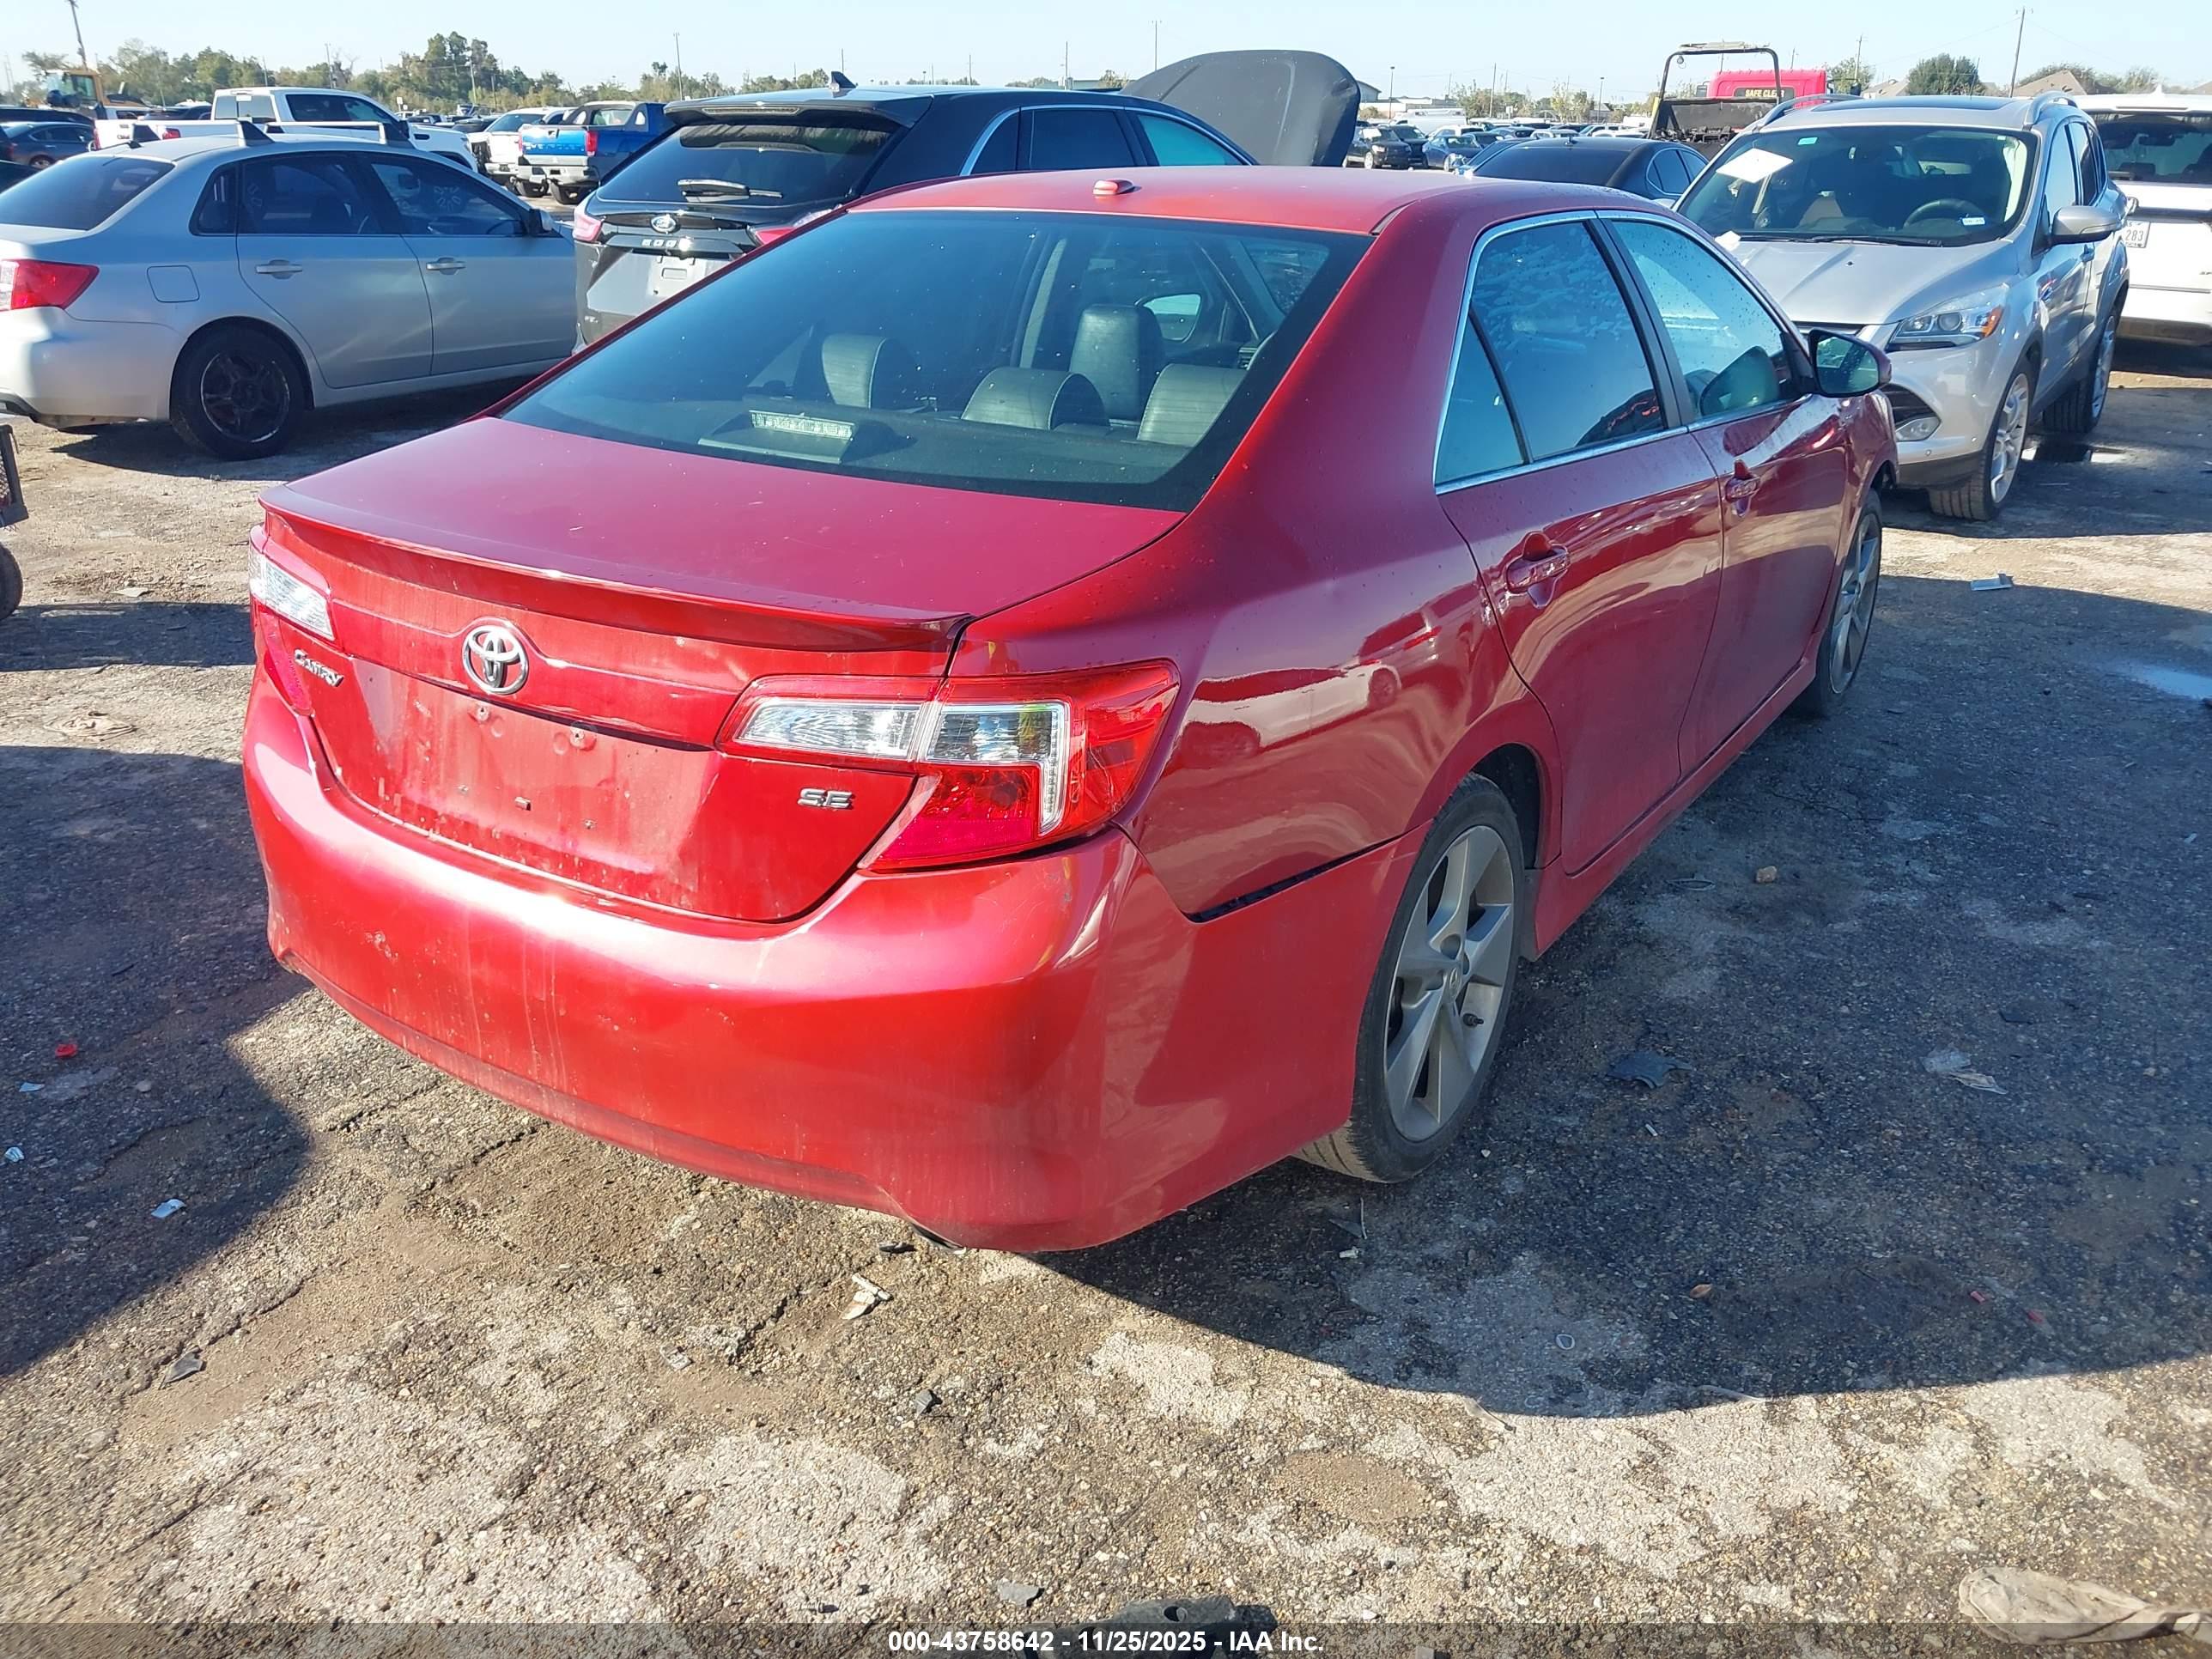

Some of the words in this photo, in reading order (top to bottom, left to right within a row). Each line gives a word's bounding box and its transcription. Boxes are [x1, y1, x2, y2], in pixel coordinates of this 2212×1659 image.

[2125, 229, 2144, 240] 283
[295, 649, 343, 686] CAMRY
[797, 787, 853, 809] SE
